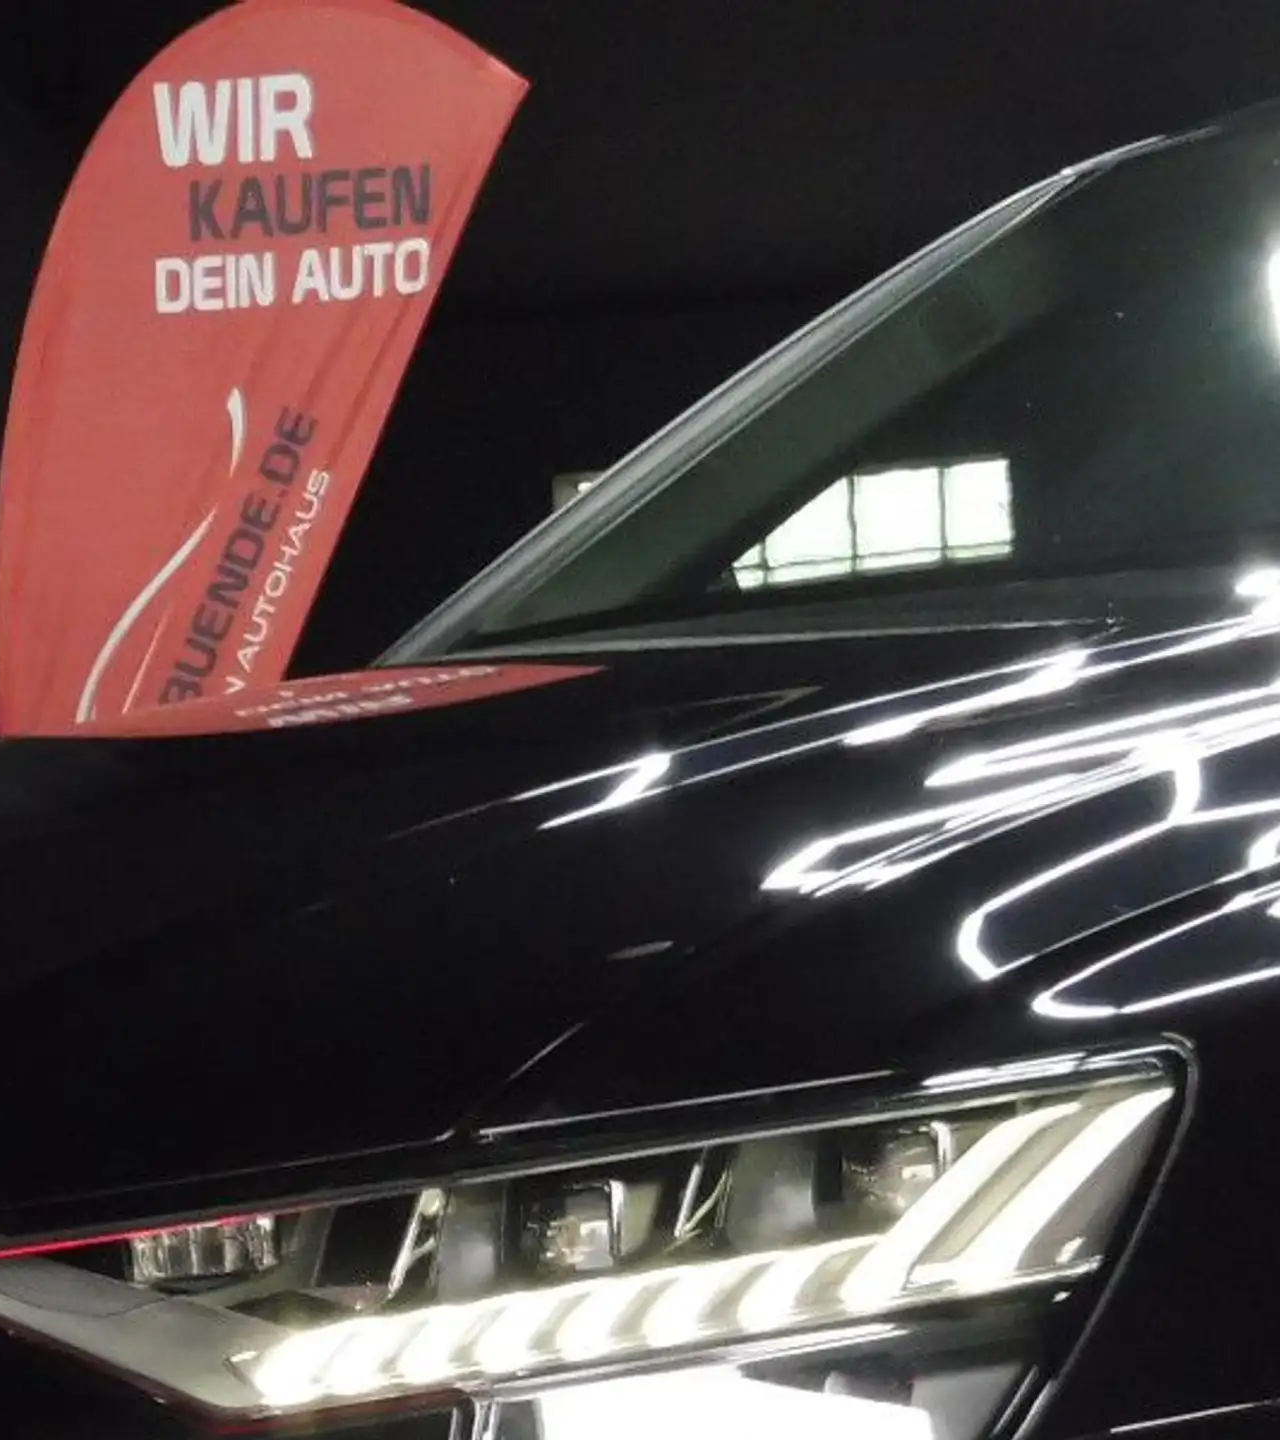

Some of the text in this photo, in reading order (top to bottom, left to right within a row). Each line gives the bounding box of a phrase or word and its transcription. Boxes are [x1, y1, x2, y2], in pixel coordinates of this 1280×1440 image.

[153, 73, 314, 167] WIR
[188, 165, 433, 241] KAUFEN
[155, 238, 432, 314] DEIN AUTO
[236, 469, 331, 673] AUTOHAUS
